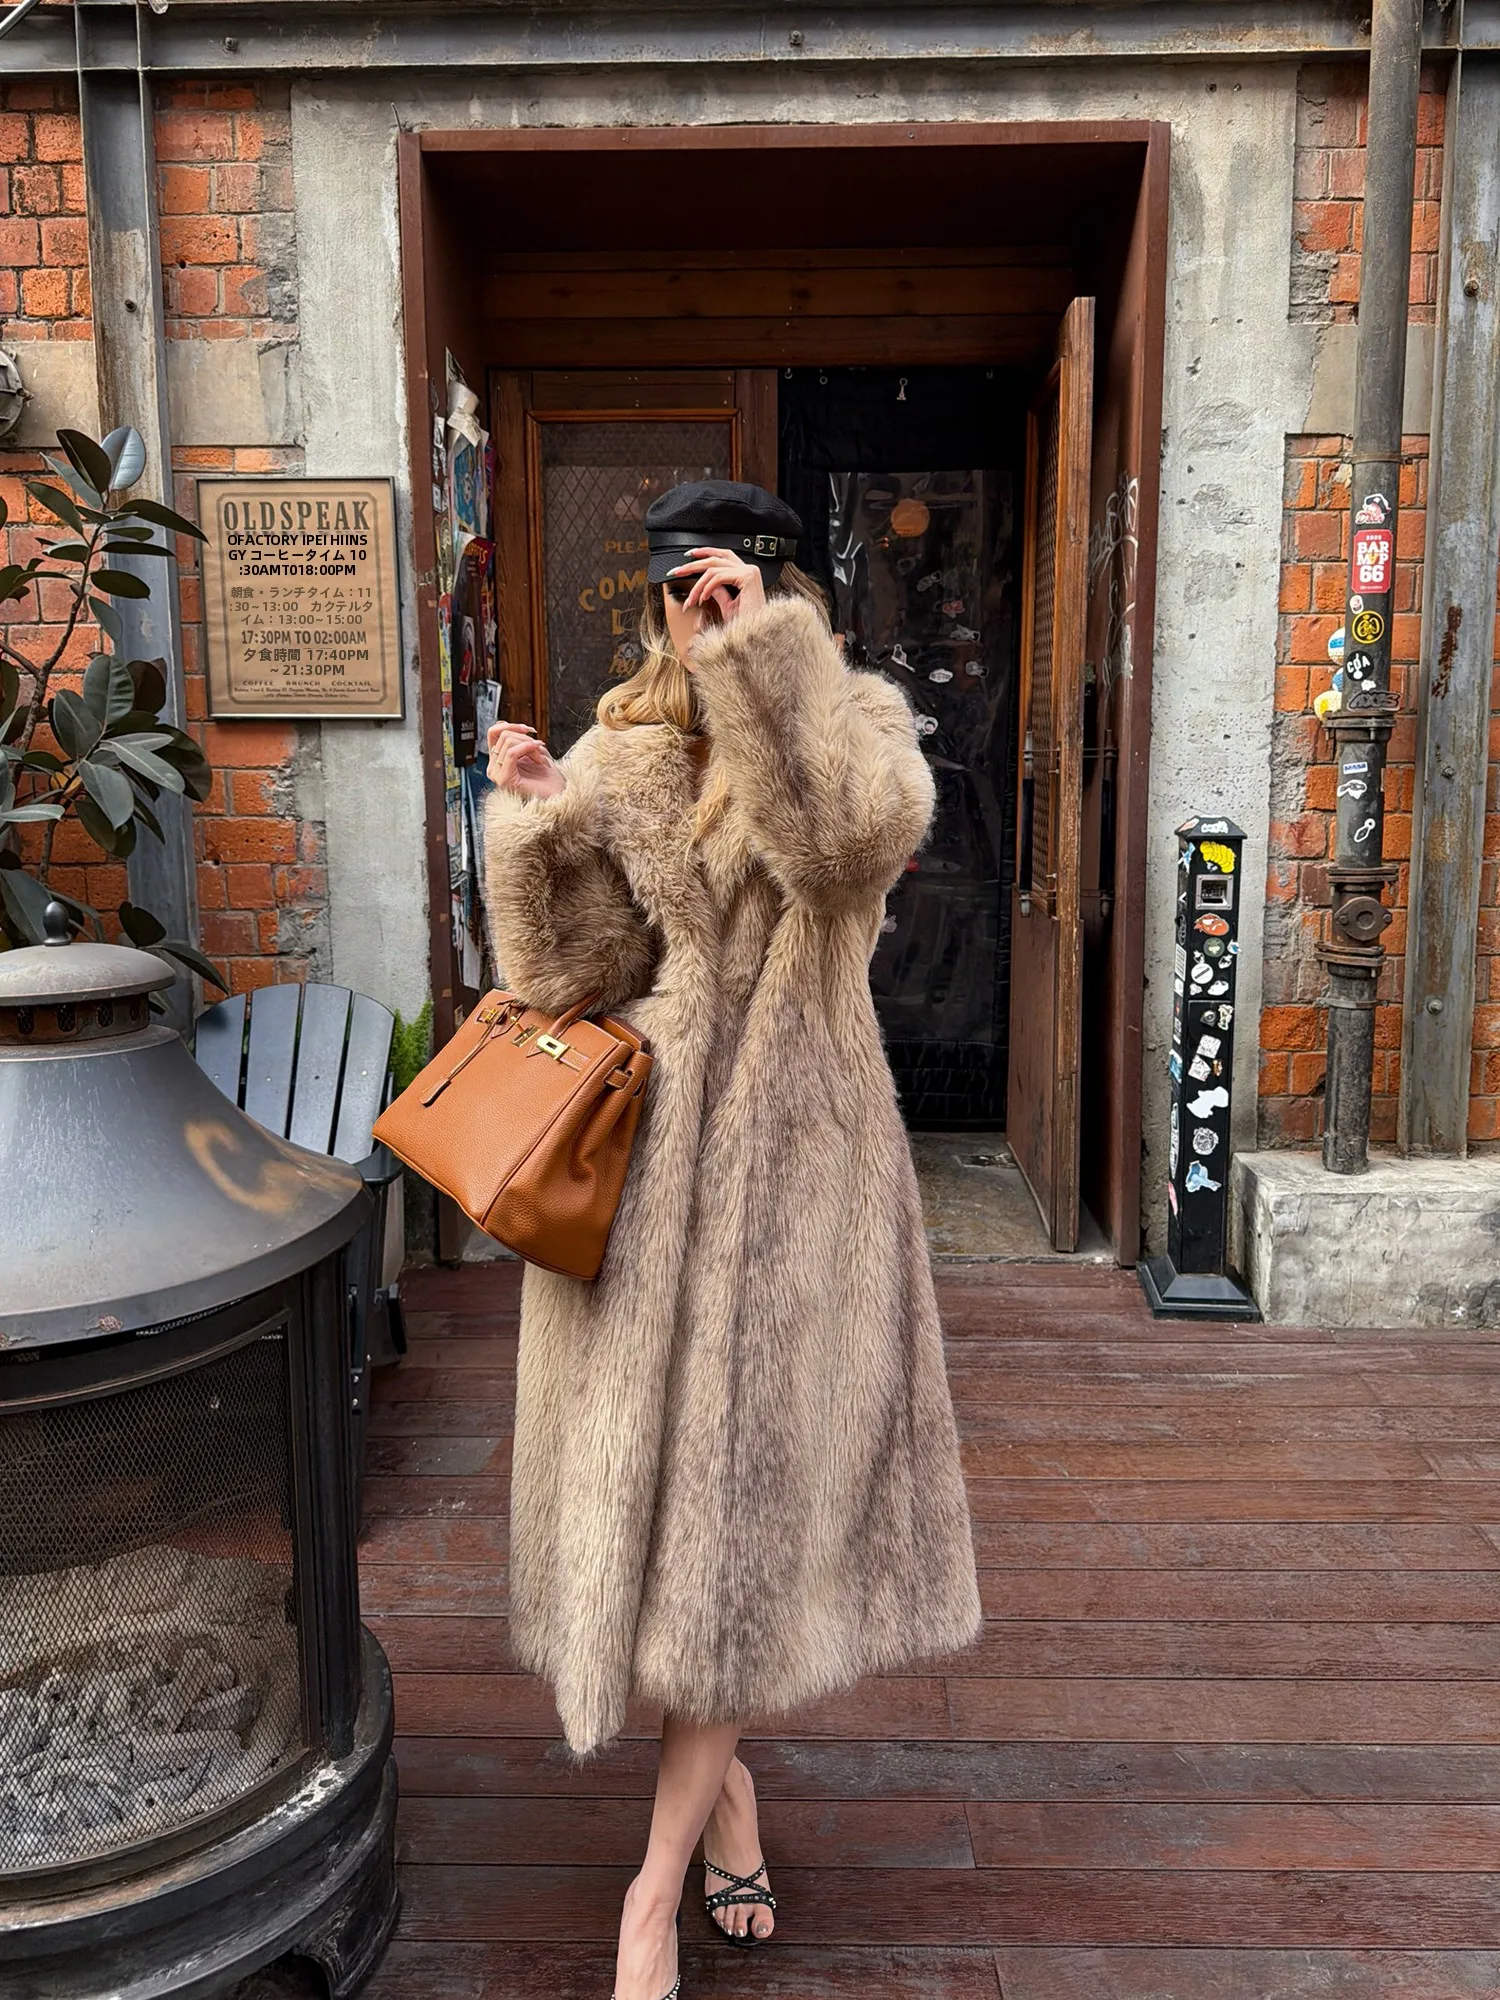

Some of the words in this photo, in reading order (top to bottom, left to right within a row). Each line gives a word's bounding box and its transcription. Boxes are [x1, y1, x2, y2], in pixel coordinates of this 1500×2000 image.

[223, 501, 370, 531] OLDSPEAK
[227, 534, 299, 546] OFACTORY
[302, 534, 327, 546] IPEI
[330, 534, 368, 546] HIINS
[1357, 541, 1389, 554] BAR
[228, 549, 247, 561] GY
[250, 549, 346, 562] コーヒータイム
[350, 549, 367, 561] 10
[1359, 564, 1385, 583] 66
[310, 600, 374, 613] カクテルタ
[241, 630, 291, 645] 17:30PM
[294, 630, 312, 645] TO
[314, 630, 367, 645] 02:00AM
[243, 647, 301, 662] 夕食時間
[307, 649, 369, 661] 17:40PM
